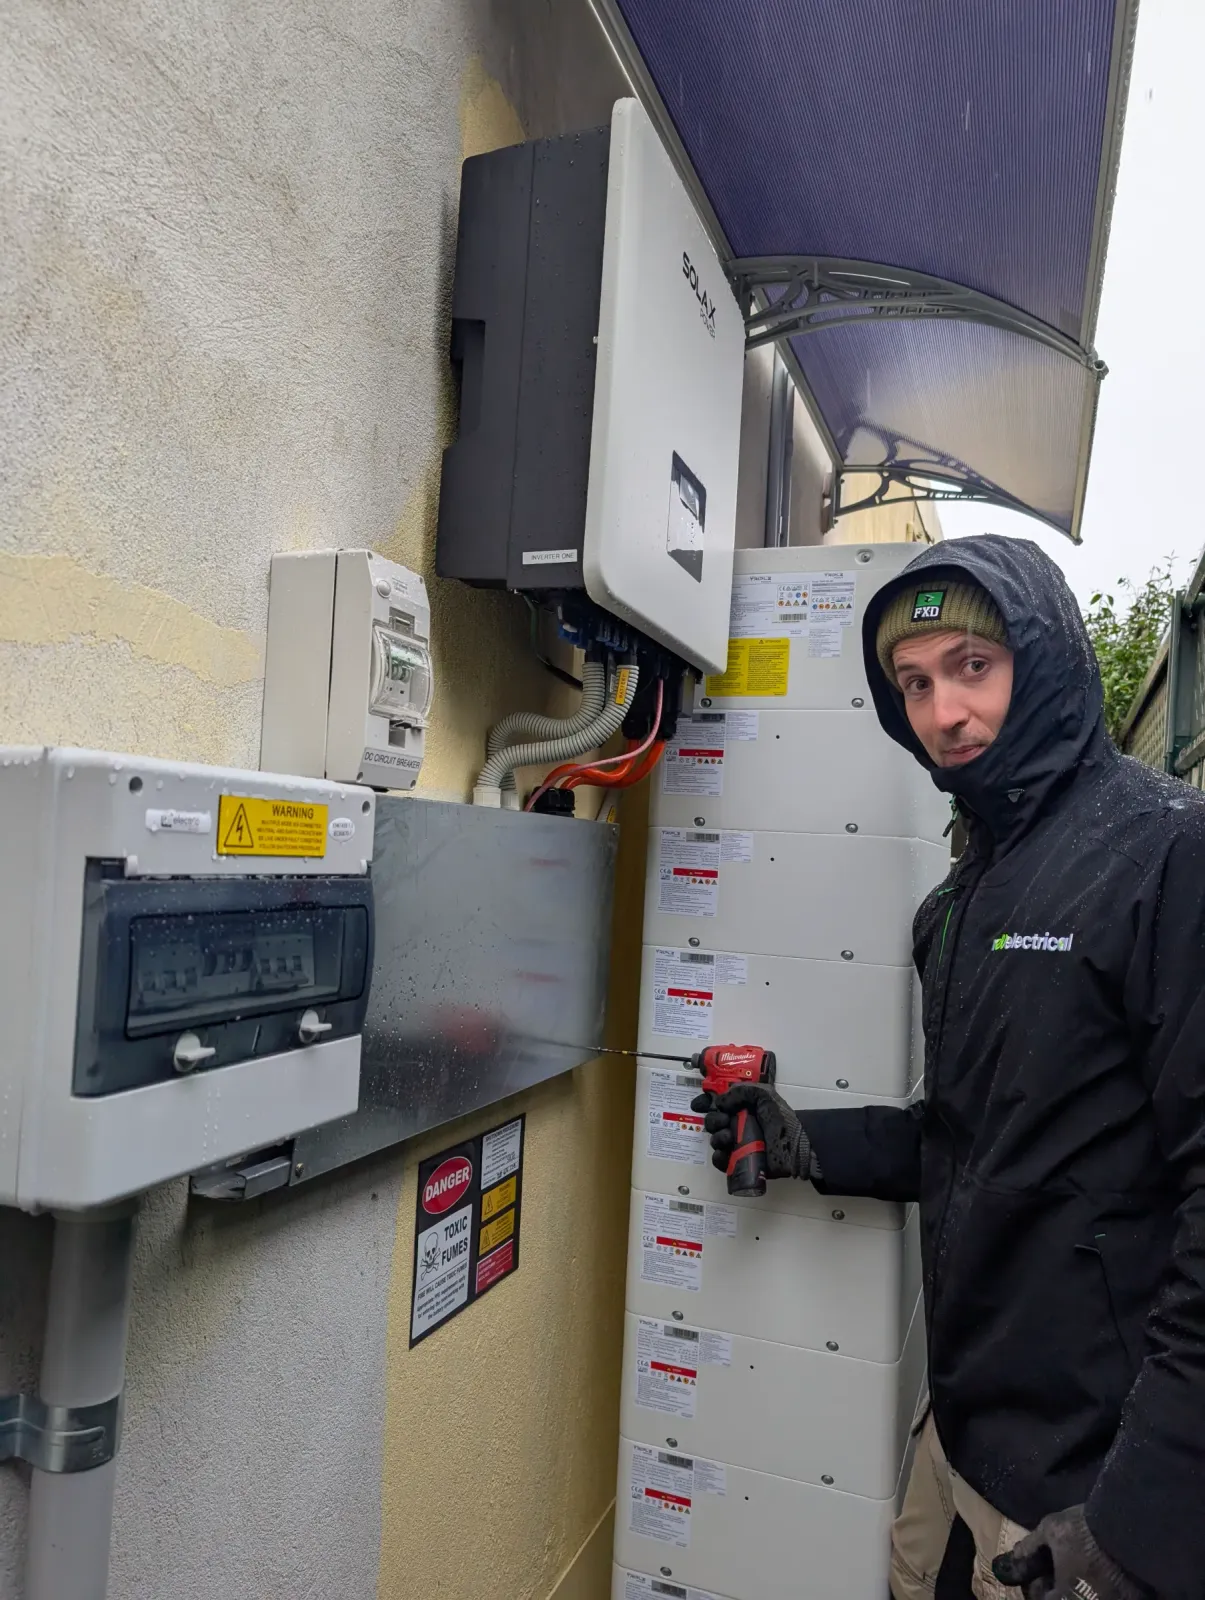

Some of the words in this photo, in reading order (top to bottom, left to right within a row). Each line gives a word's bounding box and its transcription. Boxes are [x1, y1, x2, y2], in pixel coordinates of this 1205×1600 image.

[682, 251, 716, 328] SOLAX
[531, 553, 560, 561] INVERTER
[561, 552, 575, 560] ONE
[913, 606, 940, 618] FXD
[364, 751, 374, 761] DC
[374, 753, 397, 765] CIRCUIT
[396, 757, 421, 769] BREAKER
[272, 804, 315, 819] WARNING
[425, 1166, 470, 1202] DANGER
[444, 1215, 468, 1241] TOXIC
[441, 1237, 468, 1266] FUMES
